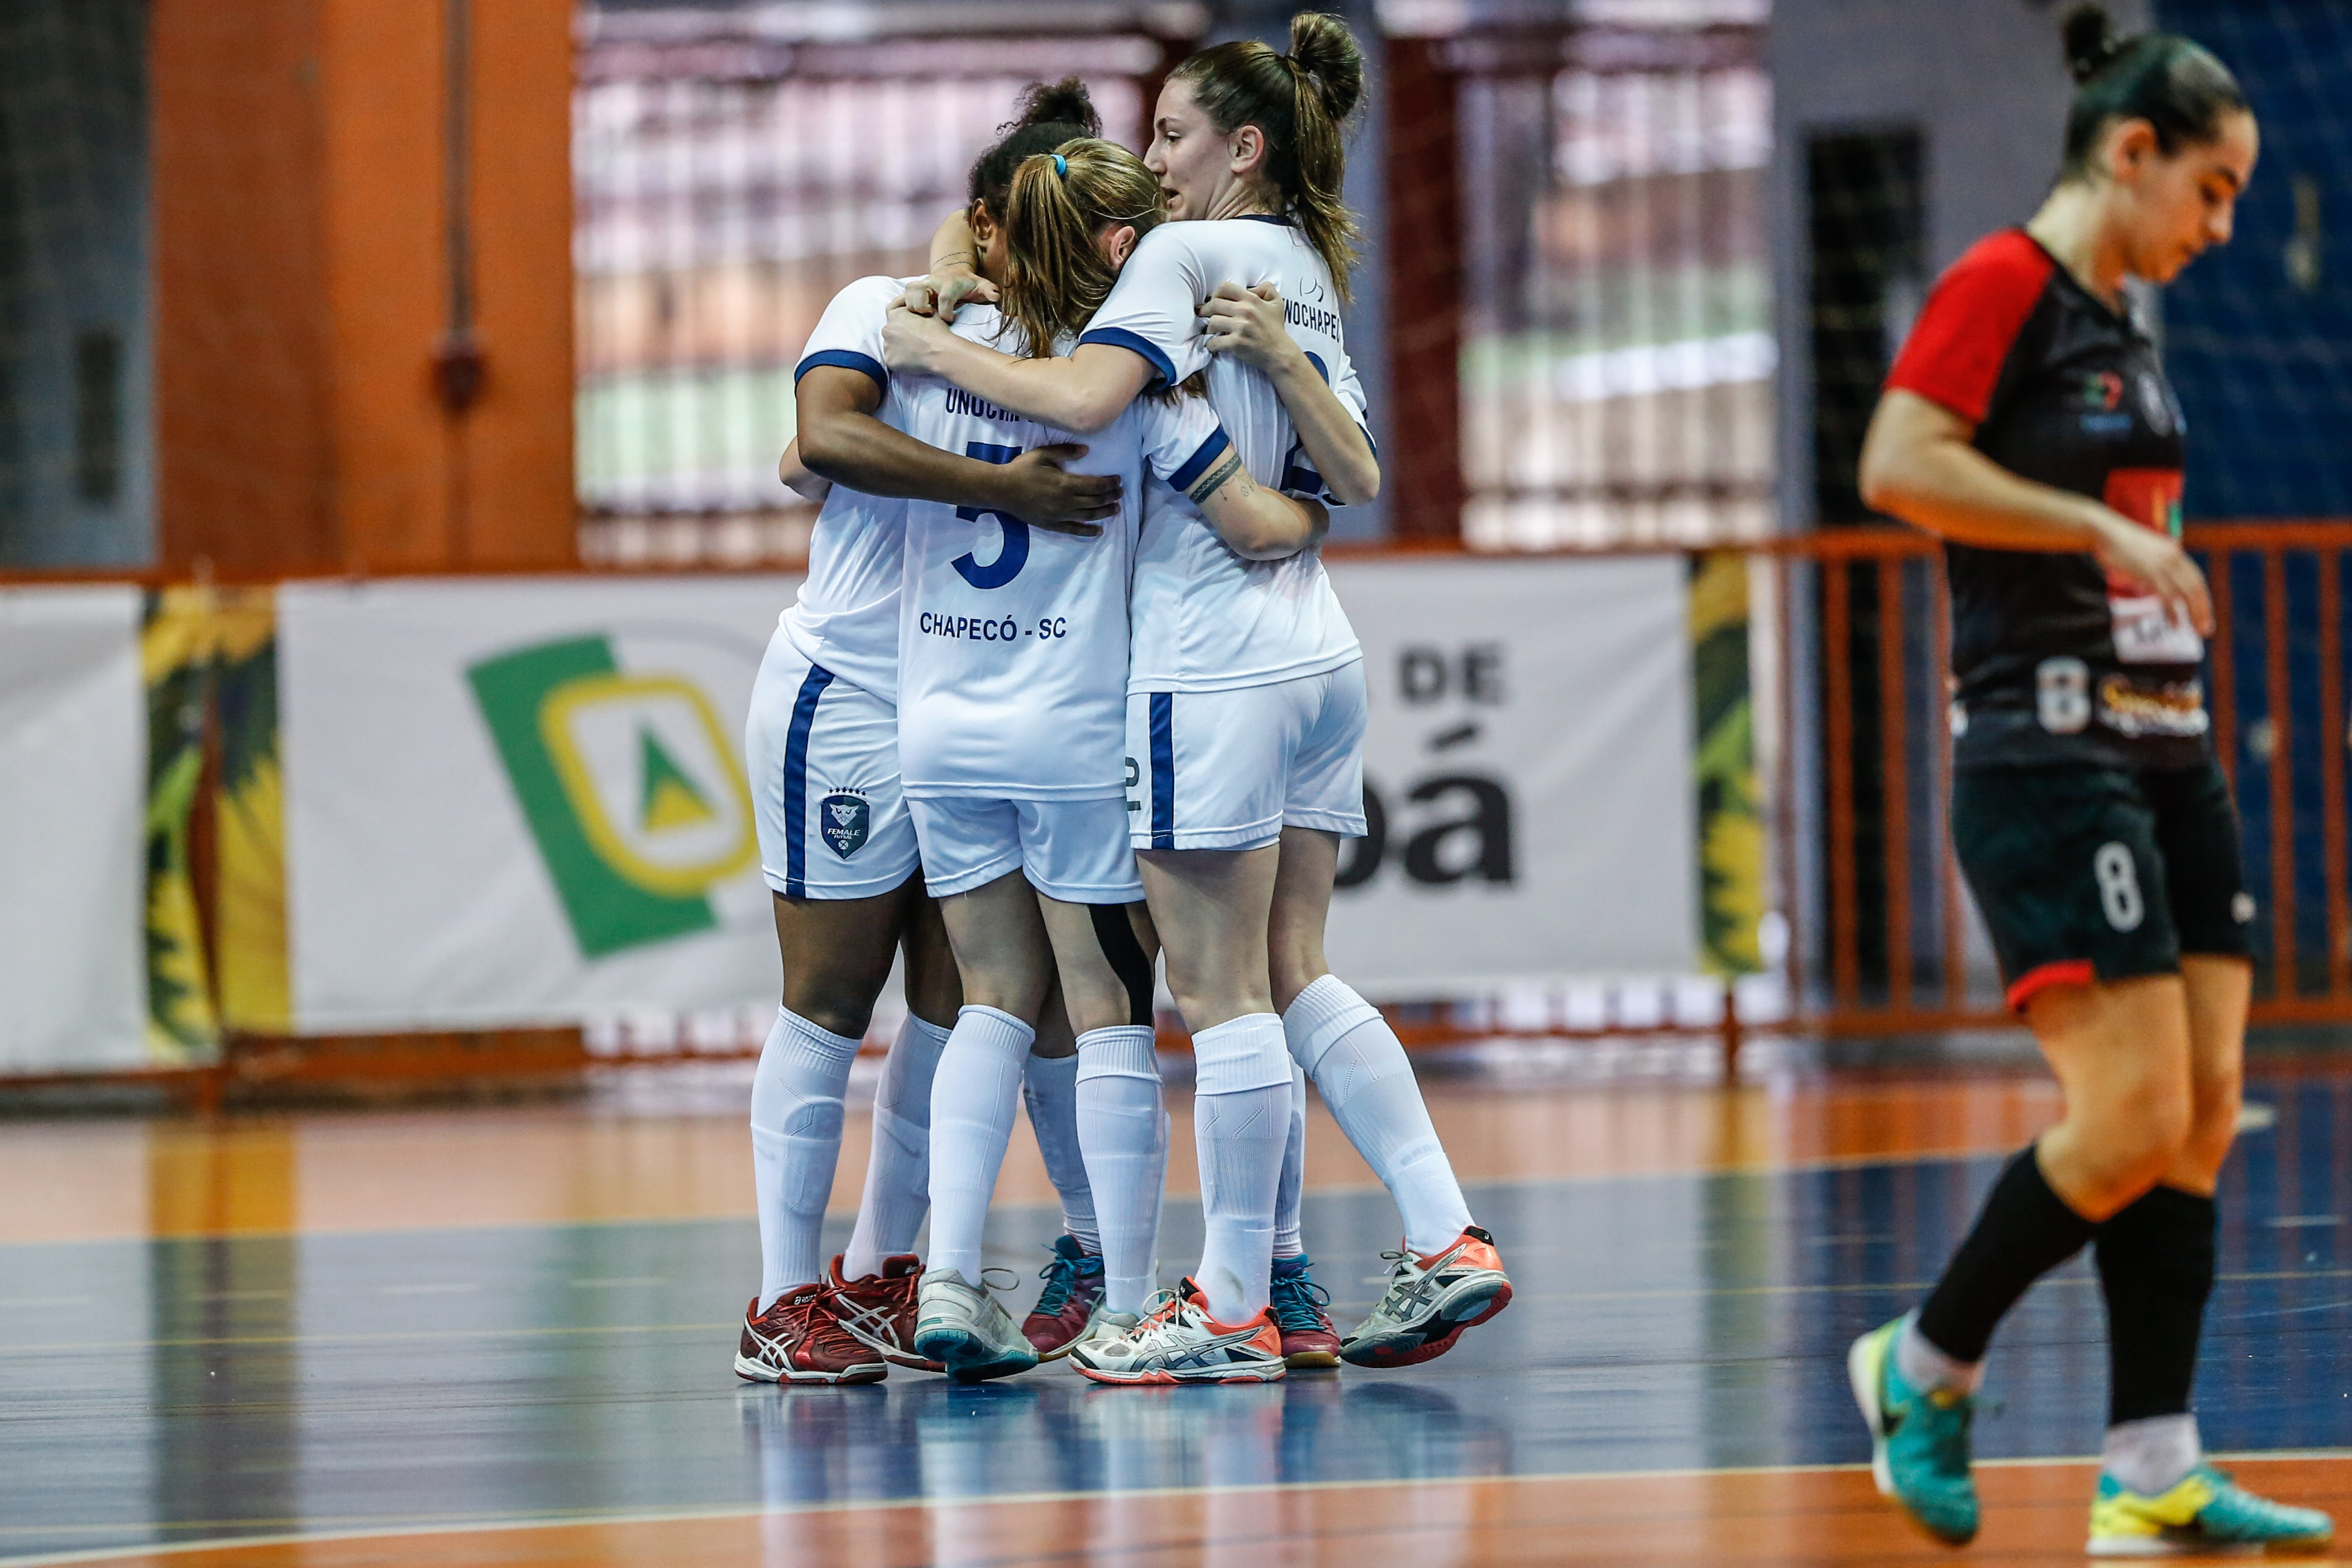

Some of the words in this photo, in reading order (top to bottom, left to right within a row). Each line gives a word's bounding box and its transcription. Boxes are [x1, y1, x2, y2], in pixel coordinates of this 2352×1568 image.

[1282, 298, 1341, 343] NOCHAPEC
[951, 441, 1030, 589] 5
[920, 612, 1015, 642] CHAPECÓ
[1039, 617, 1067, 640] SC
[1399, 644, 1503, 706] DE
[2035, 656, 2090, 734] 8
[2093, 840, 2145, 933] 8
